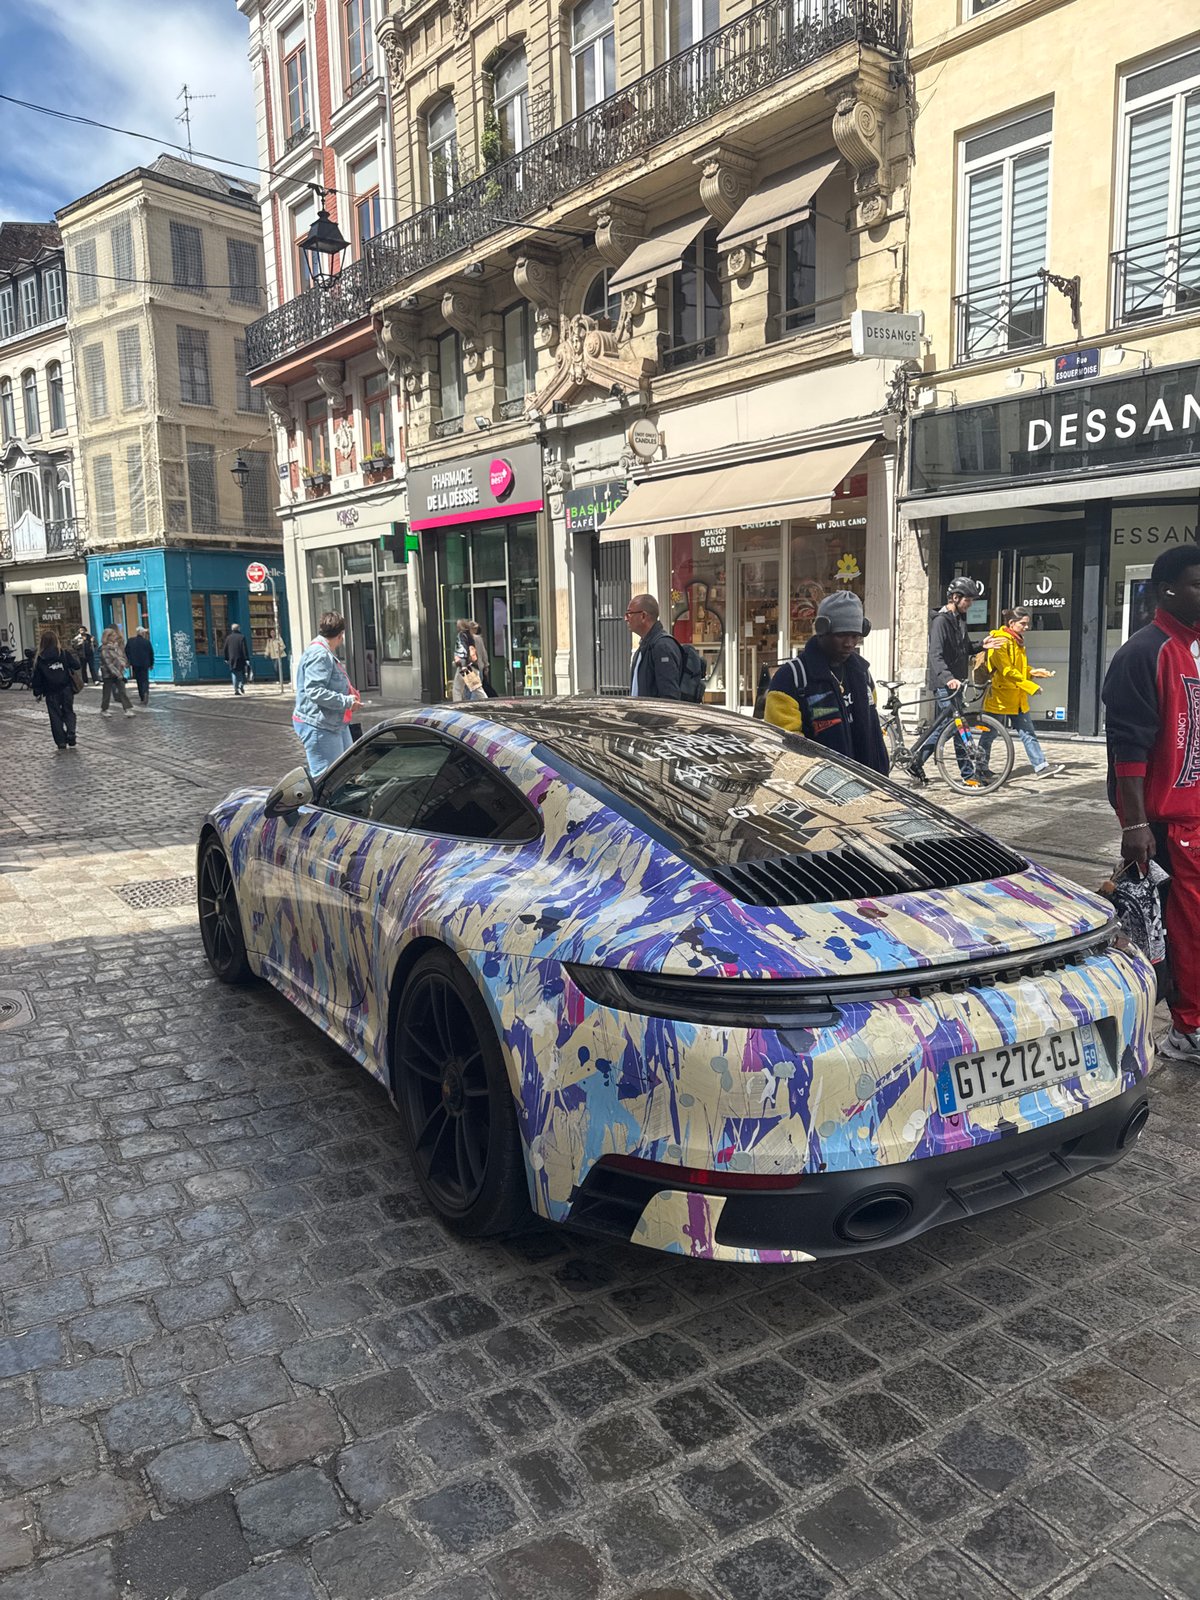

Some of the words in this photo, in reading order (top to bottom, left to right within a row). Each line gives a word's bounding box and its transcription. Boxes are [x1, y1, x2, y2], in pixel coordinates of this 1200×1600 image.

[866, 326, 917, 342] DESSANGE
[1056, 364, 1098, 380] ESQUERMOISE
[1027, 393, 1200, 452] DESSAN
[432, 466, 473, 490] PHARMACIE
[427, 495, 438, 511] DE
[438, 491, 449, 509] LA
[449, 486, 479, 507] DÉESSE
[571, 515, 594, 528] CAFÉ
[816, 522, 826, 530] MY
[828, 520, 846, 529] JOLIE
[847, 517, 867, 526] CAND
[708, 545, 725, 553] PARIS
[1023, 597, 1066, 607] DESSANGE
[1177, 712, 1187, 749] LONDON
[727, 804, 760, 819] GT
[954, 1031, 1080, 1099] GT-272-GJ
[1084, 1048, 1097, 1067] 59
[943, 1094, 950, 1105] F
[966, 1095, 1004, 1110] CENTRE
[1007, 1081, 1048, 1097] PORSCHE
